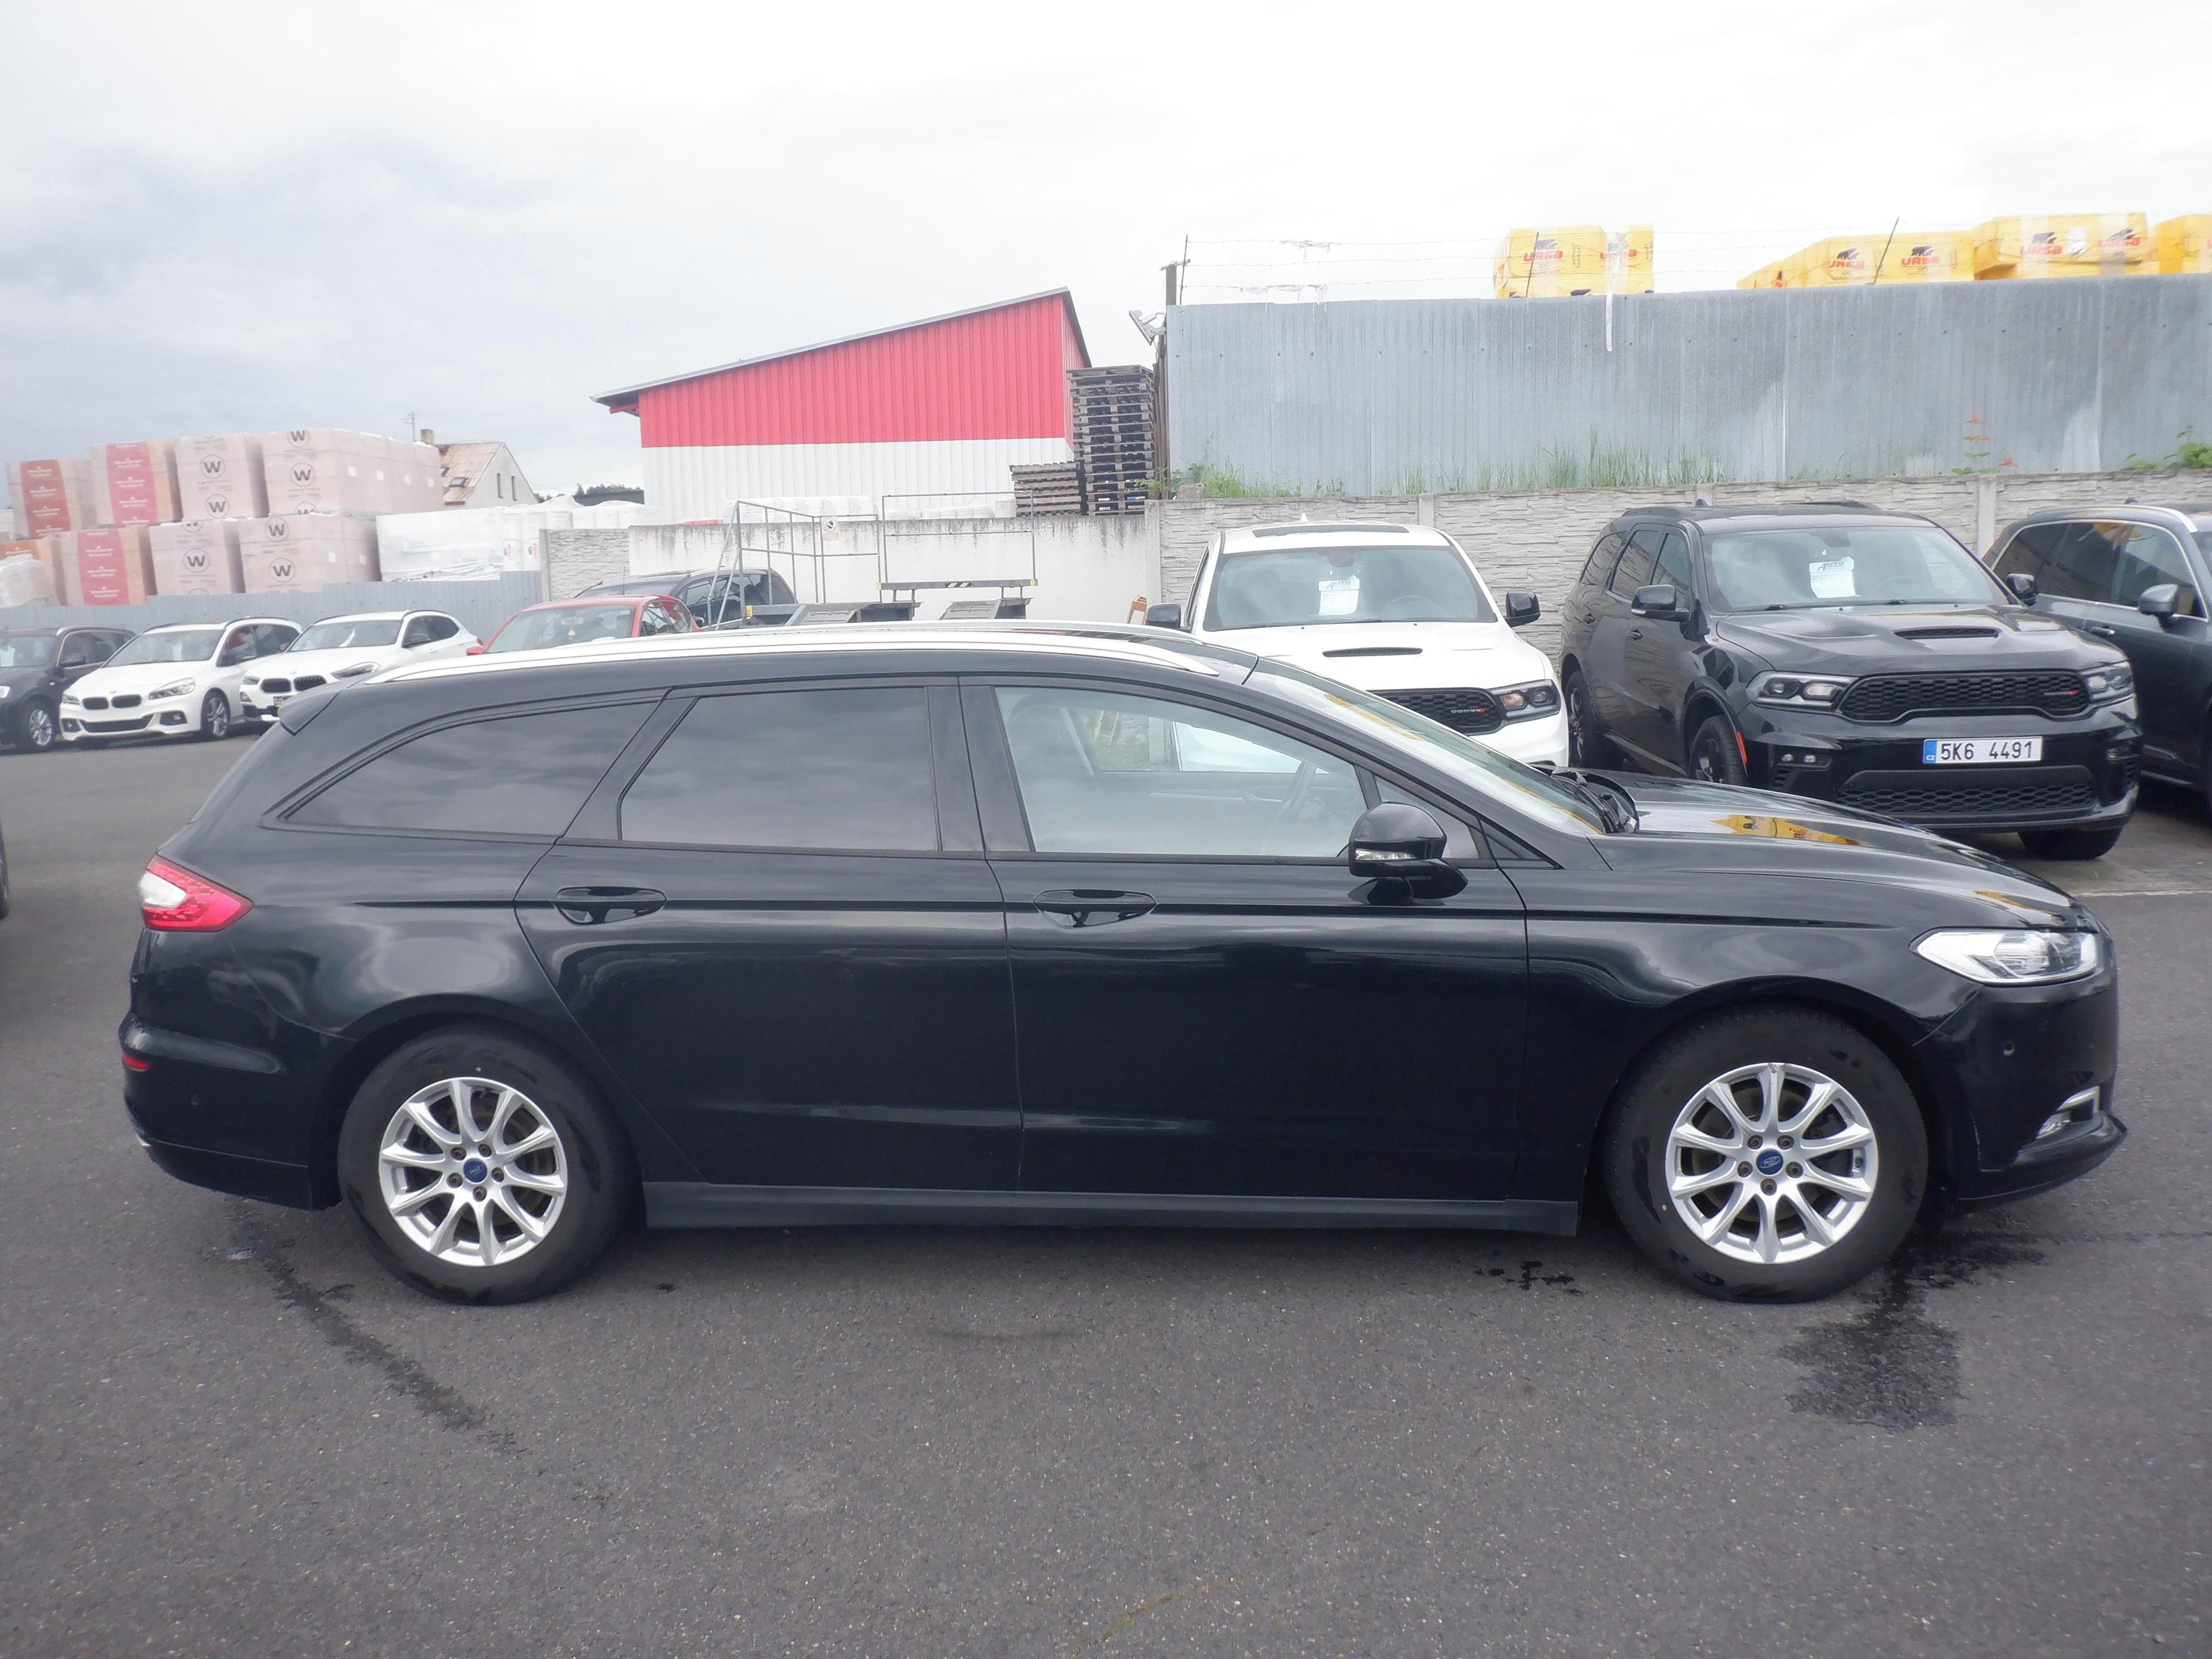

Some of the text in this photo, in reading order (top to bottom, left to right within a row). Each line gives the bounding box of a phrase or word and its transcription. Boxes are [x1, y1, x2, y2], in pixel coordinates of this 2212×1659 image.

[291, 430, 305, 442] W
[204, 461, 221, 473] W
[293, 469, 311, 481] W
[208, 501, 225, 512] W
[268, 523, 285, 536] W
[187, 555, 205, 567] W
[273, 564, 292, 576] W
[1941, 743, 1974, 760] 5K6
[1989, 741, 2032, 759] 4491
